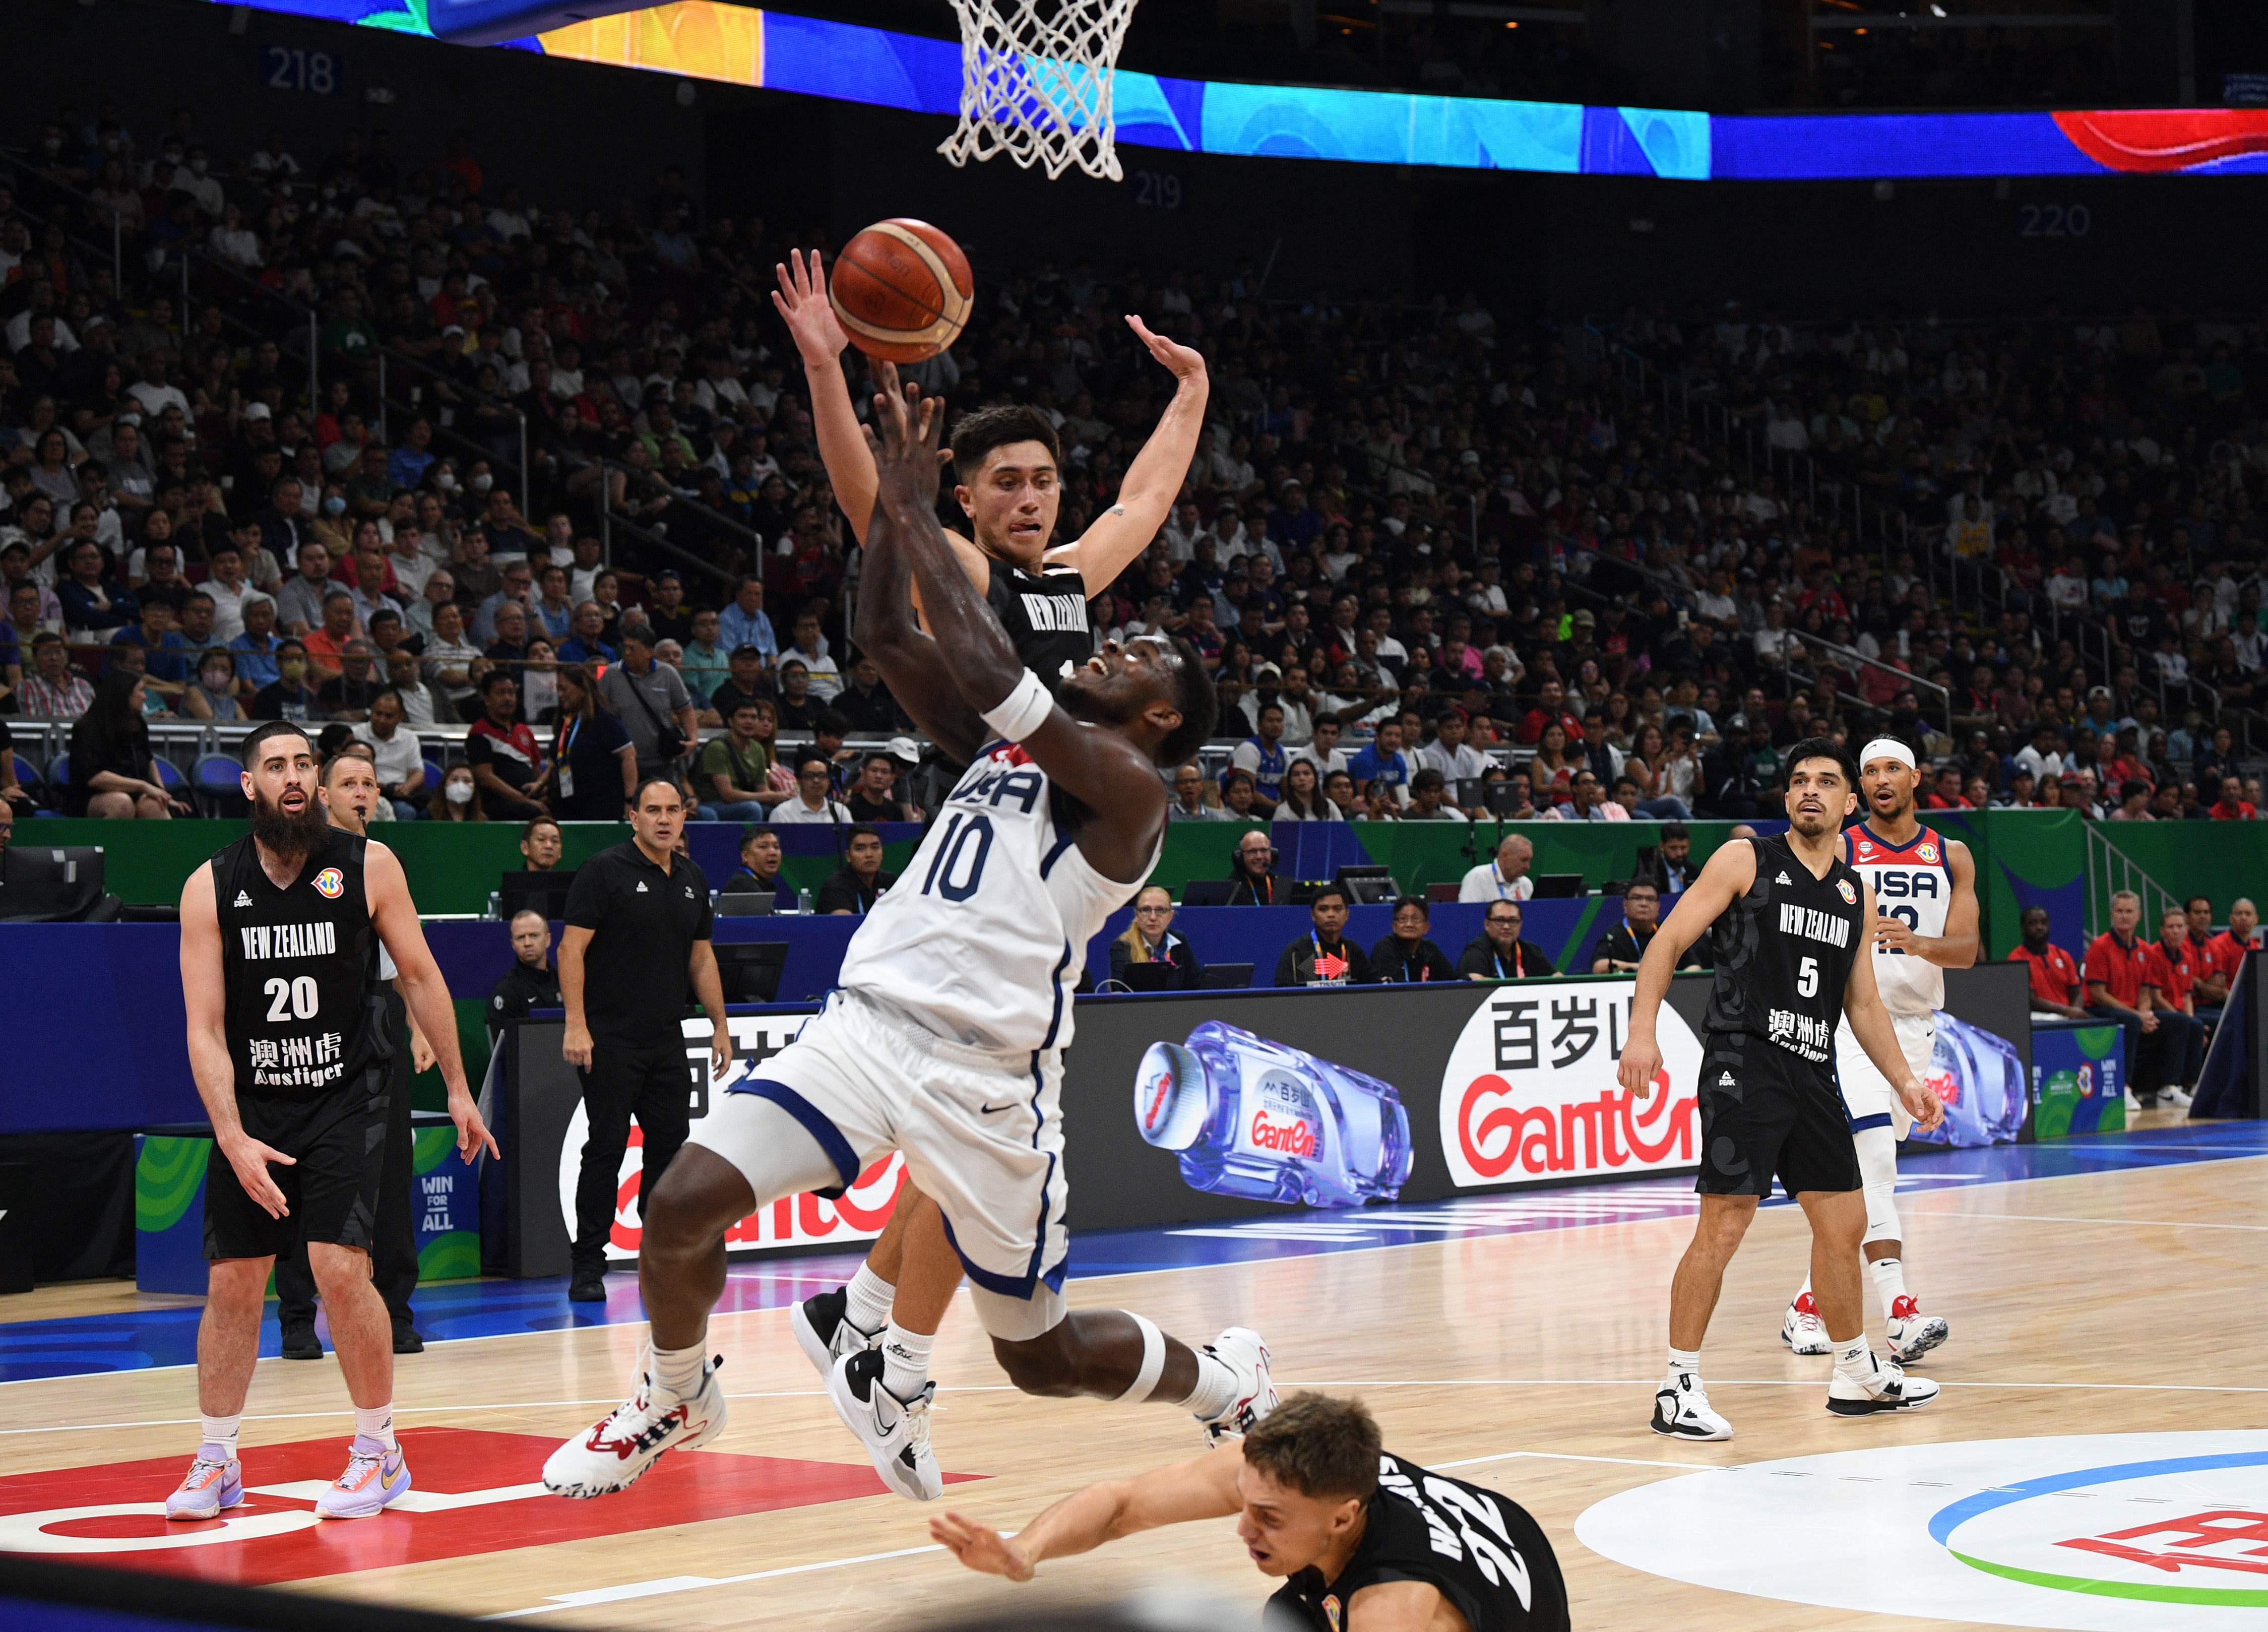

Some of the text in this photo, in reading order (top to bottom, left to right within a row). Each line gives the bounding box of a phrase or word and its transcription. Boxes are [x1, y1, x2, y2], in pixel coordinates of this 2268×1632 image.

[267, 47, 335, 94] 218
[1136, 171, 1181, 209] 219
[2020, 203, 2091, 238] 220
[1020, 593, 1055, 631] NEW
[950, 768, 1043, 814] USA
[921, 812, 994, 902] 10
[1775, 877, 1793, 886] PEAK
[234, 898, 253, 908] PEAK
[241, 921, 336, 960] NEW ZEALAND
[1780, 903, 1850, 949] NEW ZEALAND
[1797, 956, 1818, 998] 5
[264, 976, 319, 1022] 20
[1768, 1009, 1830, 1049] 澳洲虎
[249, 1032, 342, 1068] 澳洲虎
[254, 1061, 344, 1087] Austiger
[1252, 1109, 1315, 1158] Ganten
[421, 1176, 453, 1194] WIN
[427, 1195, 448, 1206] FOR
[422, 1213, 454, 1231] ALL
[887, 1344, 913, 1361] PEAK
[1422, 1475, 1532, 1613] 22
